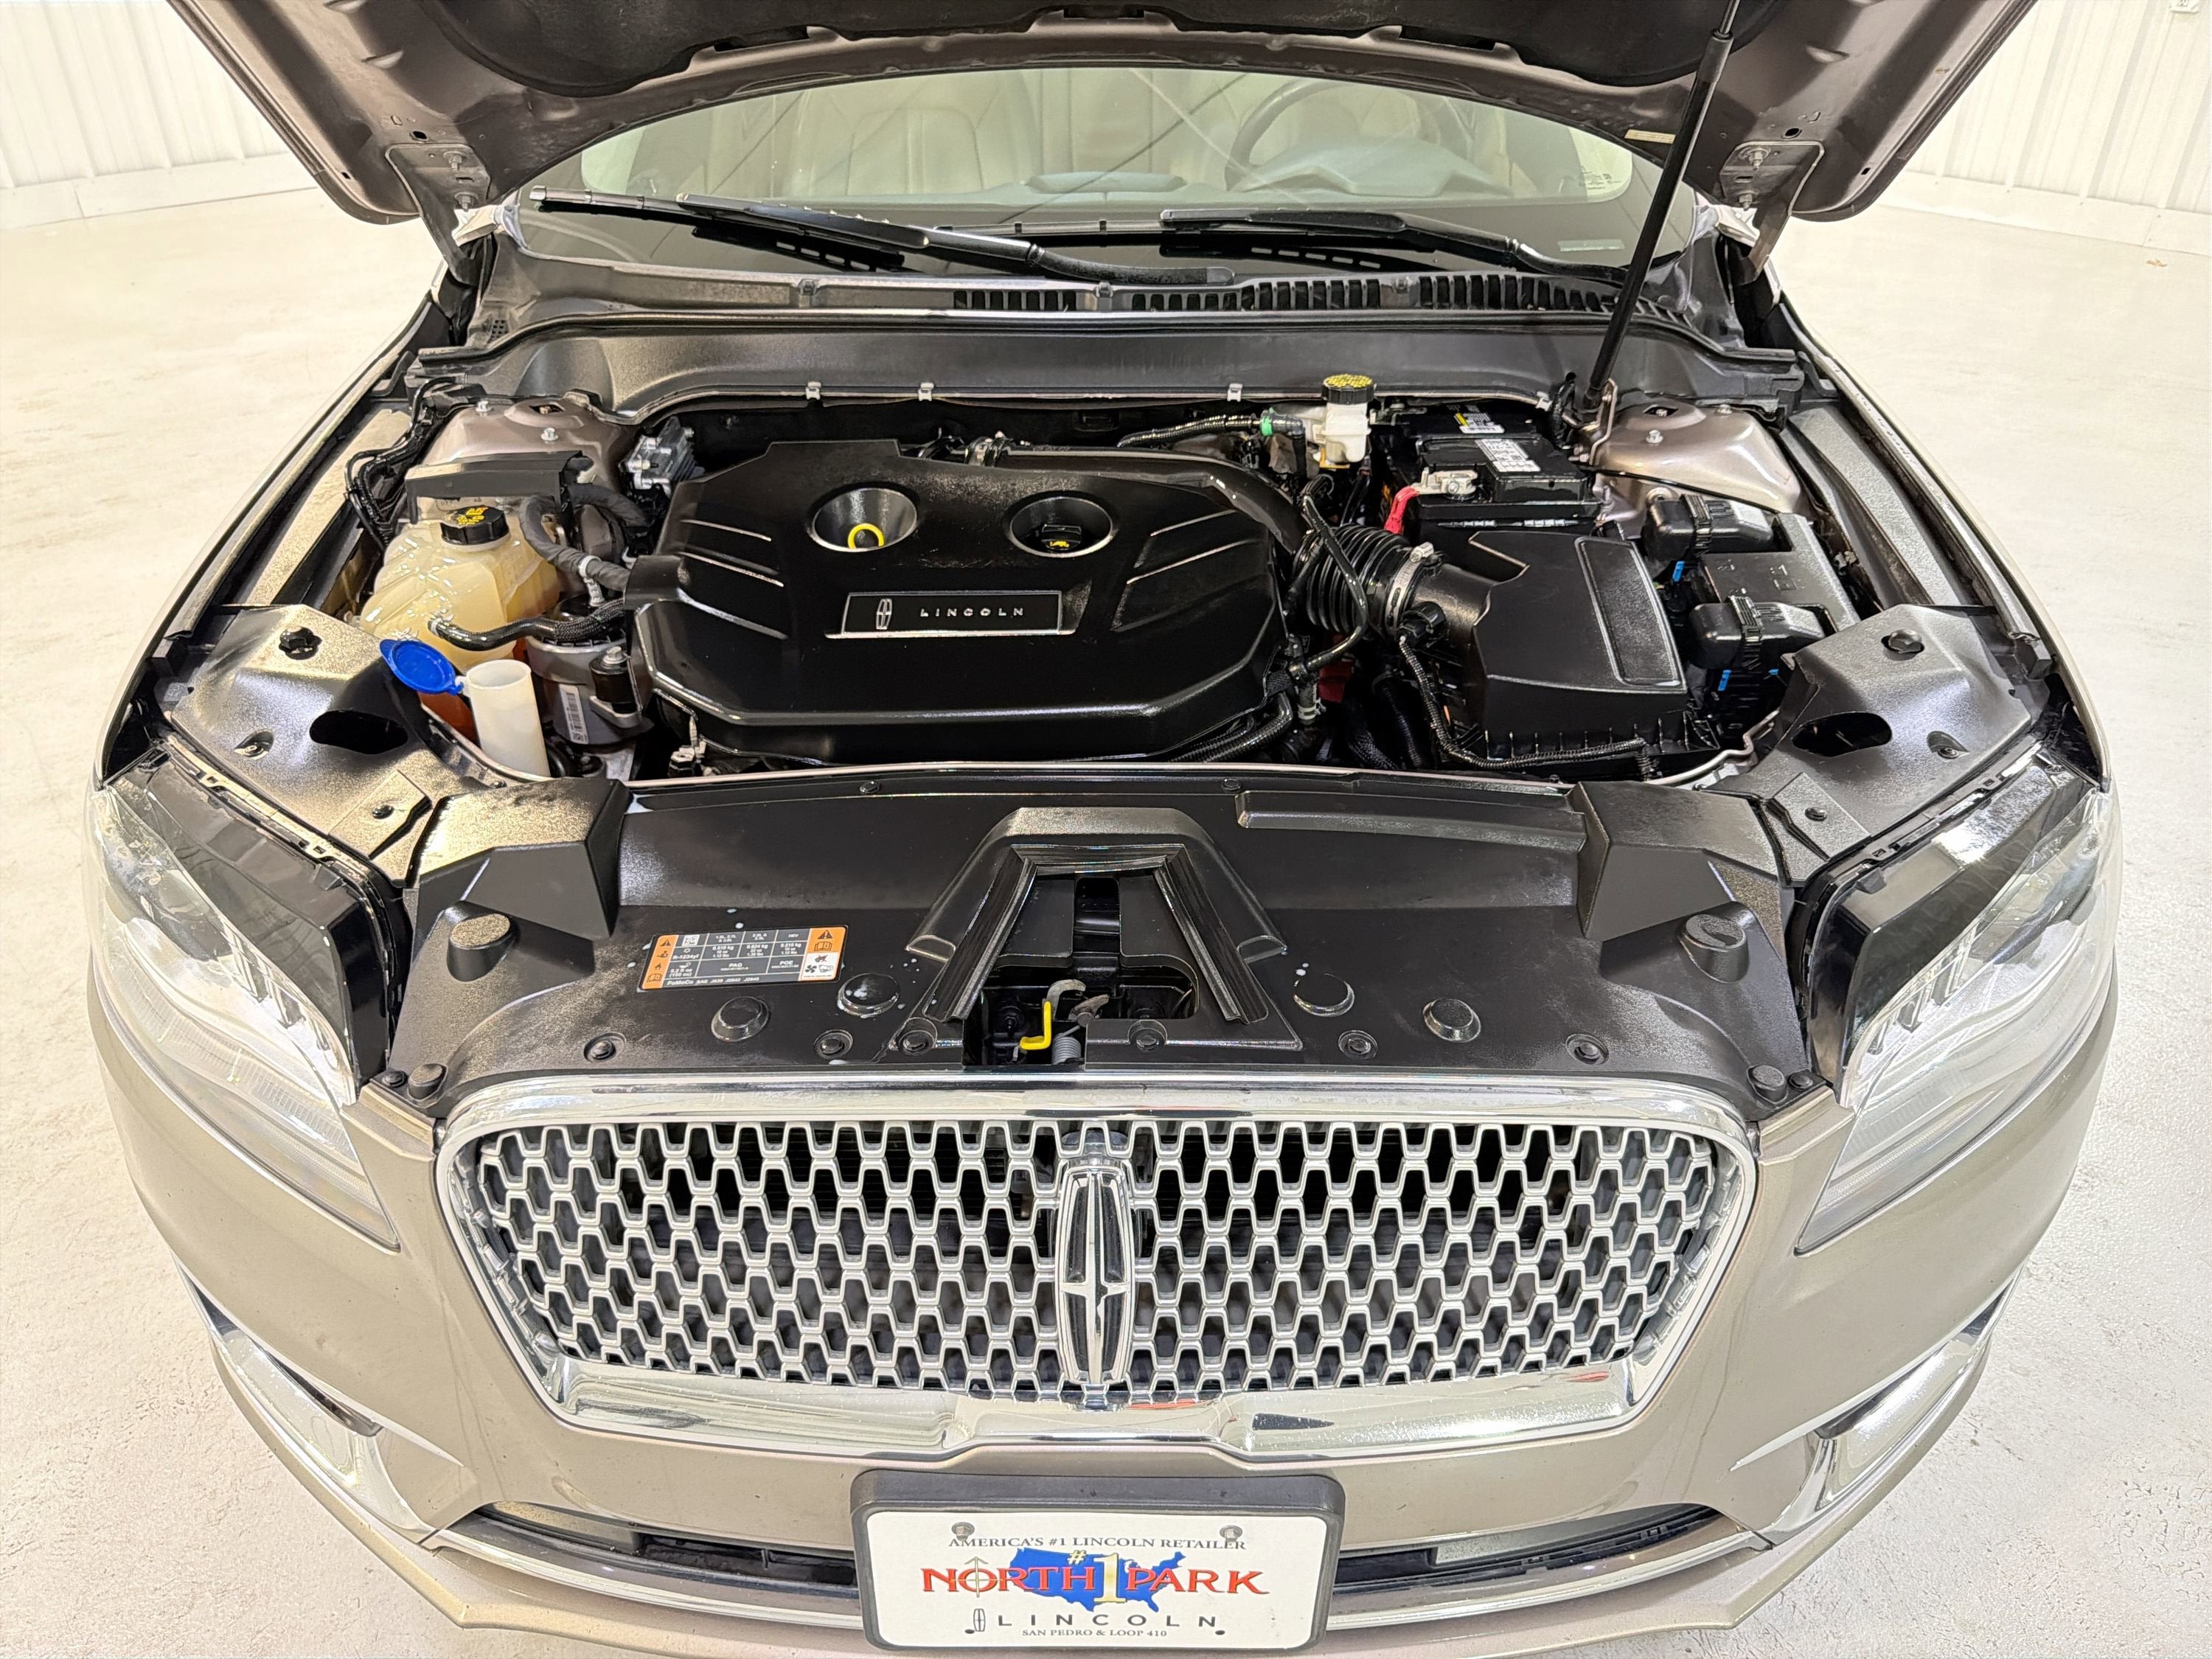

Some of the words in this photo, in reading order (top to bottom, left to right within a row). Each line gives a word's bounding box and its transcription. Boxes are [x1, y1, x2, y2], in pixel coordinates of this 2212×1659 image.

[919, 607, 1024, 617] LINCOLN
[948, 1537, 1044, 1547] AMERICA'S
[1048, 1537, 1067, 1547] #1
[1072, 1537, 1156, 1548] LINCOLN
[1160, 1538, 1247, 1550] RETAILER
[921, 1566, 1096, 1593] NORTH
[1125, 1567, 1270, 1595] PARK
[998, 1613, 1216, 1627] LINCOLN
[1022, 1629, 1046, 1637] SAN
[1050, 1629, 1093, 1637] PEDRO
[1096, 1629, 1107, 1637] &
[1146, 1630, 1167, 1638] 410
